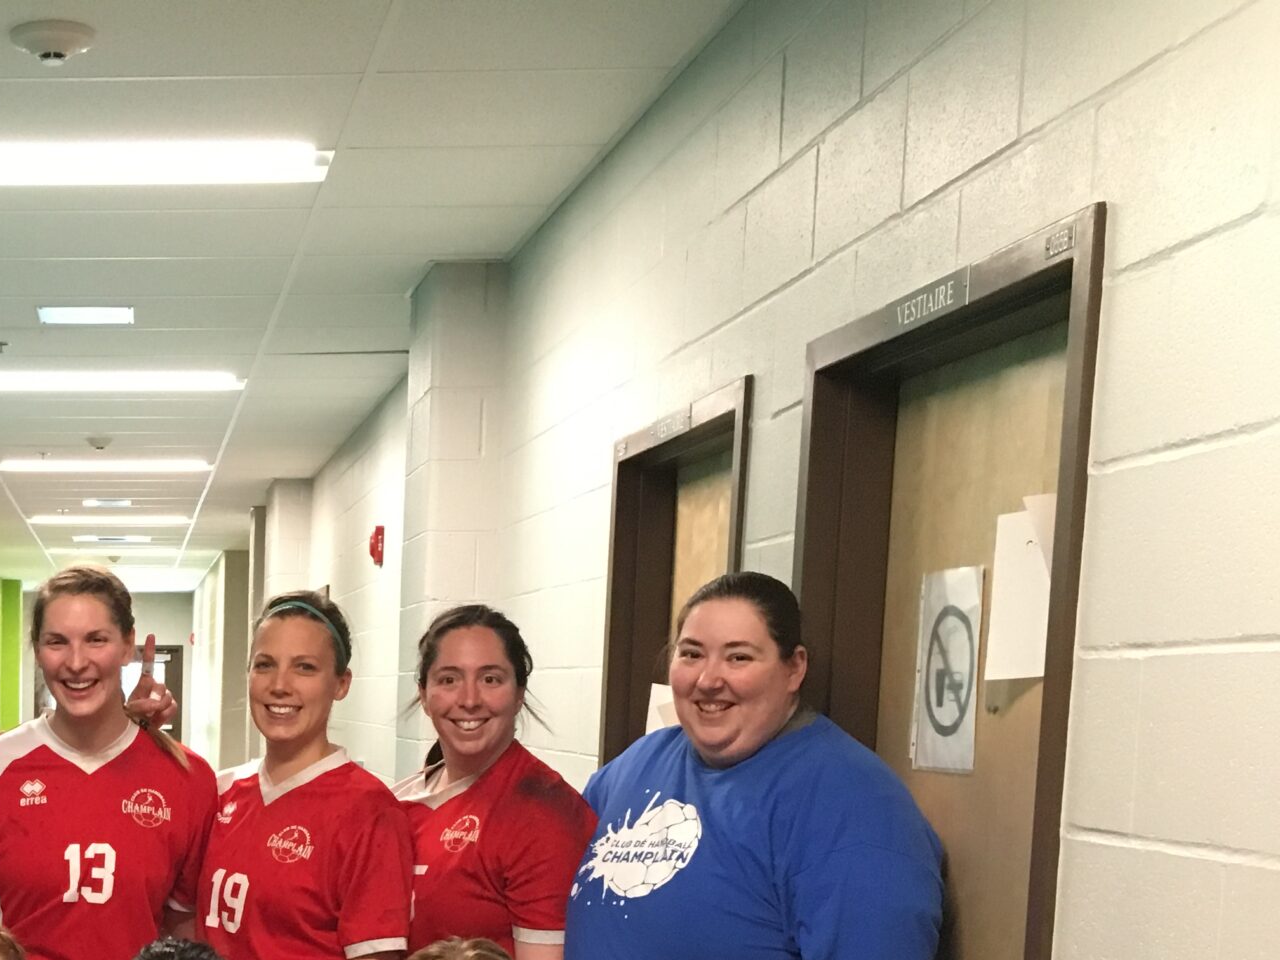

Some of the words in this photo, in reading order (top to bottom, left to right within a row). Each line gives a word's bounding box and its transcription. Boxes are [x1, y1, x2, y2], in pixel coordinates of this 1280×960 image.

[897, 280, 954, 325] VESTIAIRE
[121, 799, 172, 822] CHAMPLAIN
[62, 842, 117, 905] 13
[601, 849, 690, 864] CHAMPLAIN
[205, 868, 250, 934] 19
